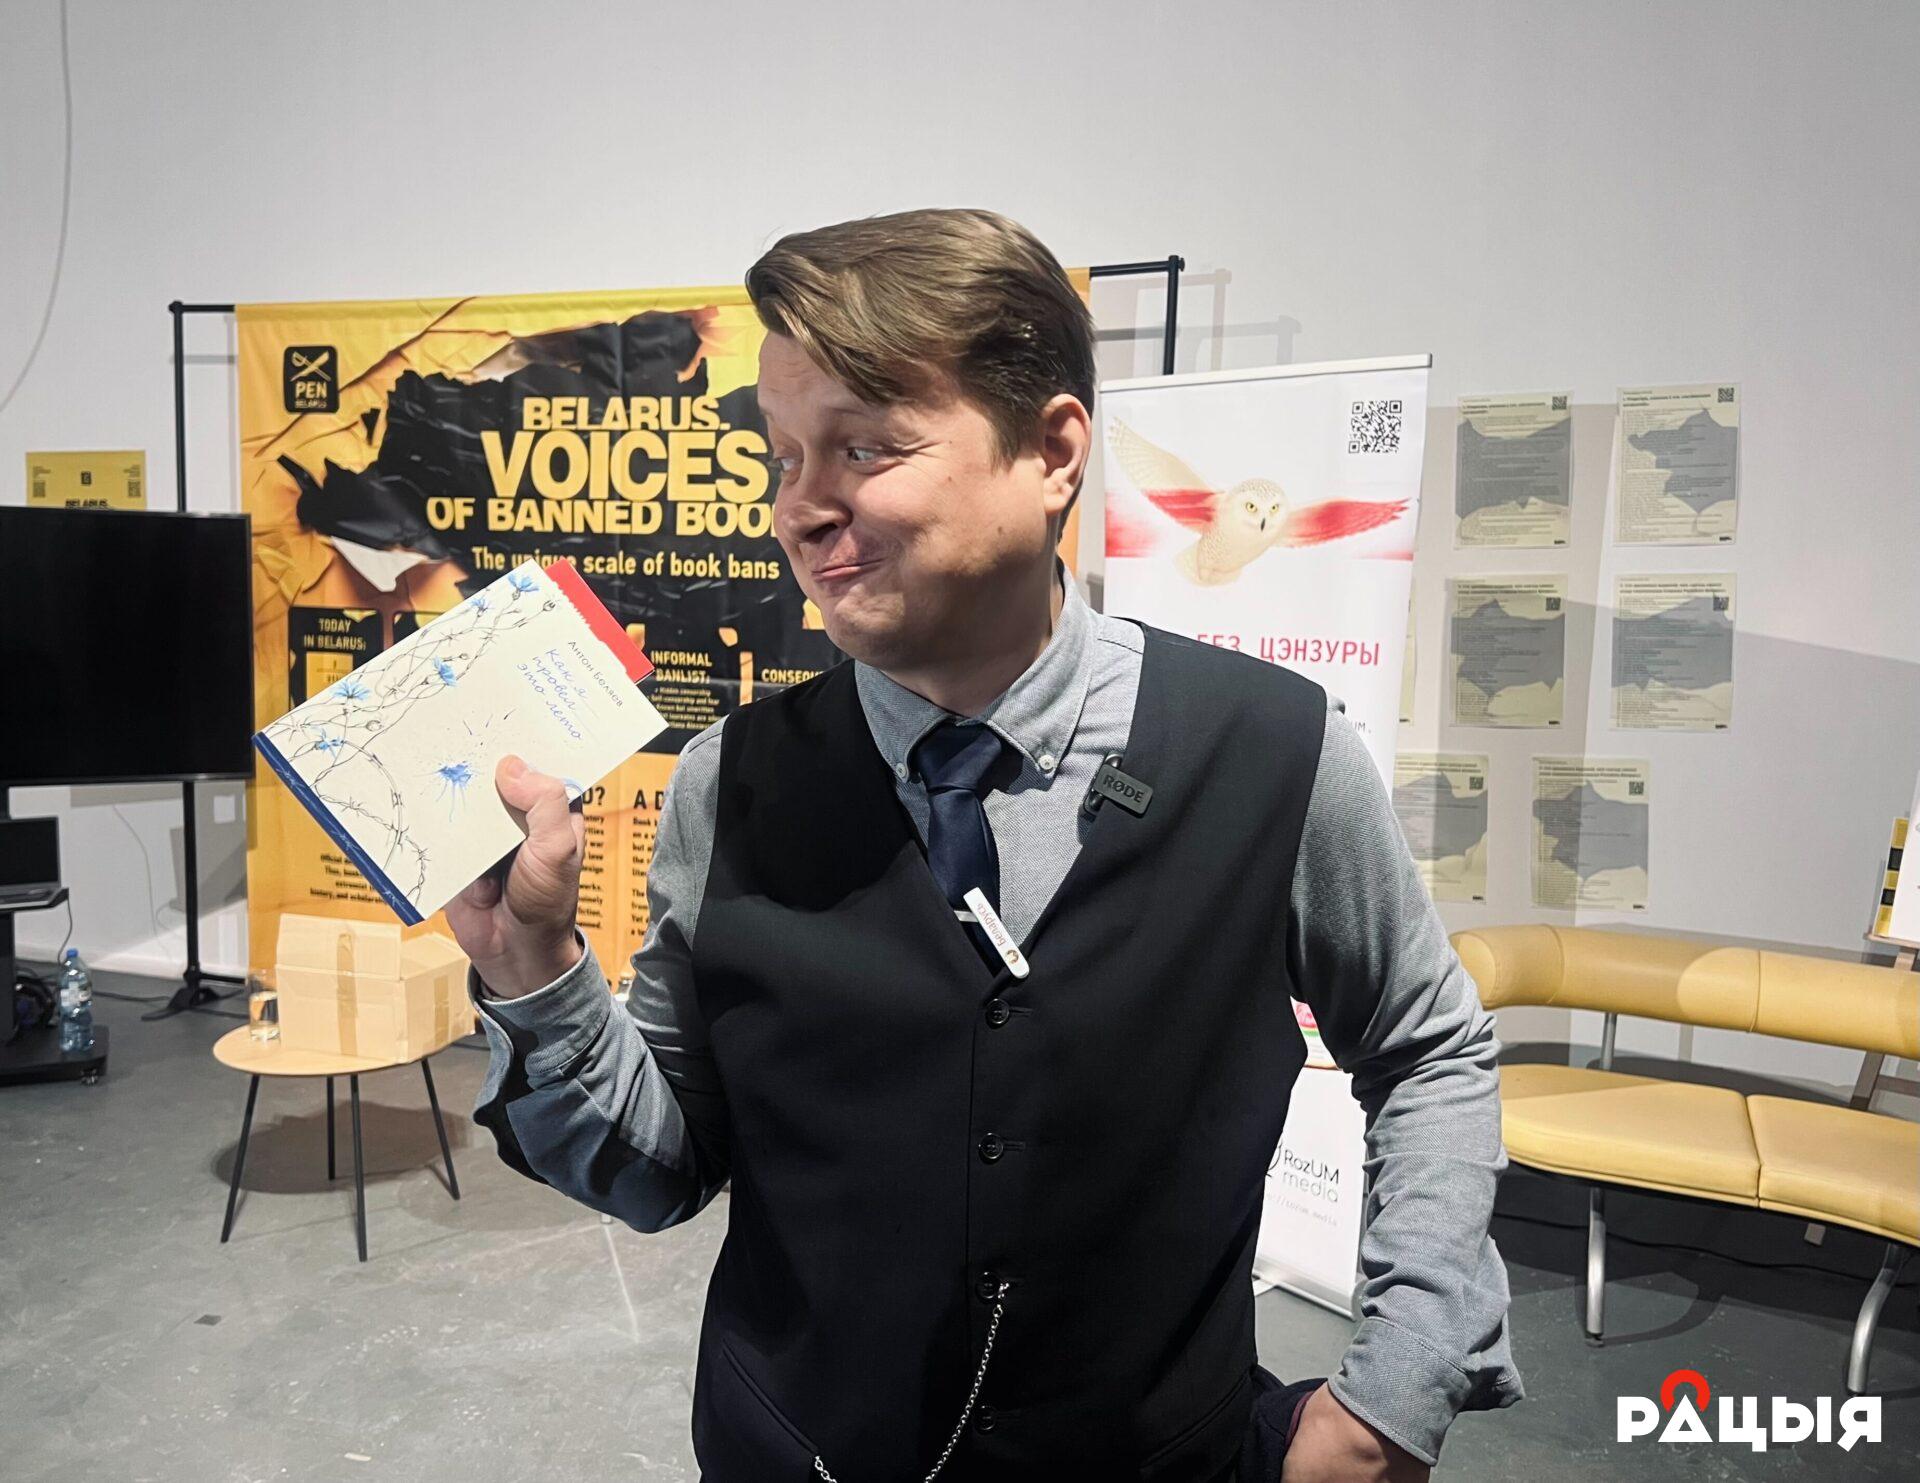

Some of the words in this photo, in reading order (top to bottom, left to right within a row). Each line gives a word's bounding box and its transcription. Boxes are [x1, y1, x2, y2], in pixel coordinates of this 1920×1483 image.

[296, 381, 327, 398] PEN
[523, 395, 731, 431] BELARUS.
[480, 429, 769, 504] VOICES
[426, 496, 476, 530] OF
[487, 497, 662, 534] BANNED
[676, 501, 777, 538] BOO
[472, 546, 505, 570] The
[583, 549, 636, 574] scale
[643, 550, 664, 575] of
[670, 552, 722, 578] book
[729, 554, 780, 580] bans
[318, 618, 352, 632] TODAY
[304, 634, 314, 646] IN
[1260, 637, 1380, 666] ЦЭНЗУРЫ
[650, 650, 712, 667] INFORMAL
[634, 790, 646, 809] A
[1103, 774, 1145, 803] RØDE
[1284, 1149, 1340, 1184] RozUM
[1282, 1172, 1339, 1203] media
